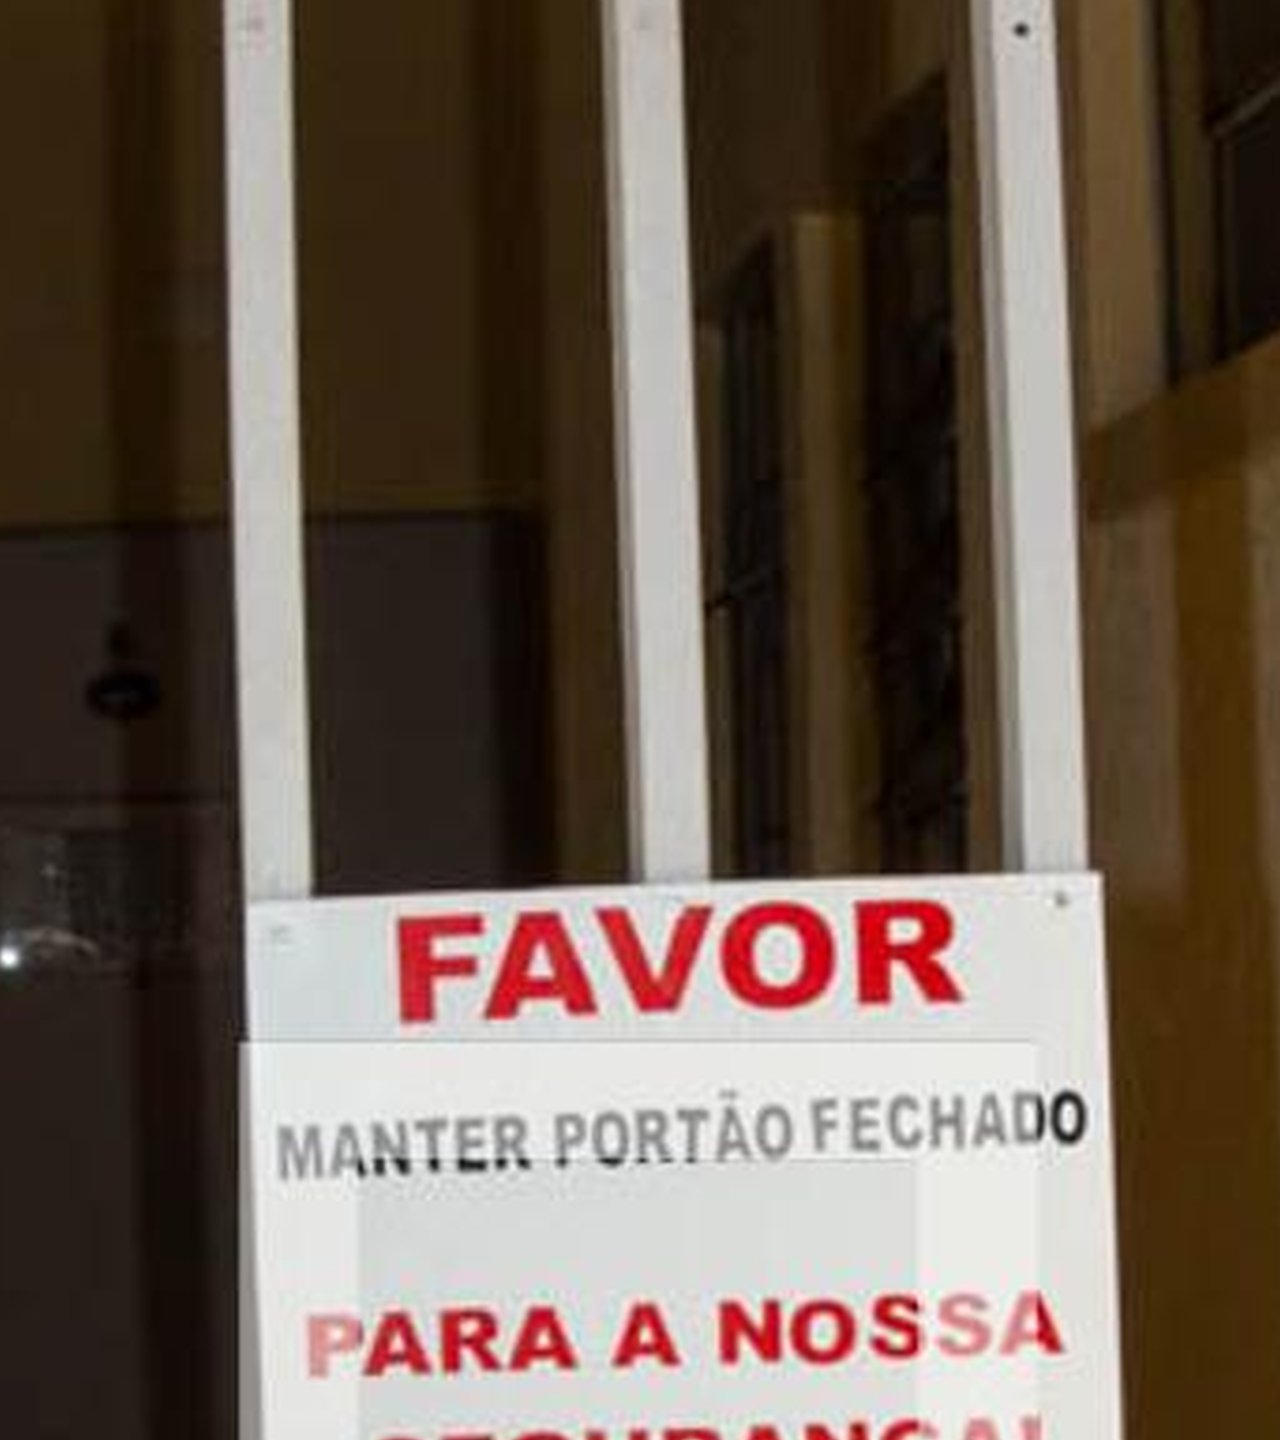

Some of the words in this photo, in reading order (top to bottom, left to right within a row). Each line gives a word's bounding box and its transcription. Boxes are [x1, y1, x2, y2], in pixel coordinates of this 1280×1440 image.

[396, 897, 964, 1027] FAVOR
[278, 1114, 533, 1182] MANTER
[552, 1089, 794, 1171] PORTÃO
[810, 1087, 1090, 1153] FECHADO
[307, 1303, 580, 1379] PARA
[611, 1299, 684, 1372] A
[713, 1288, 1066, 1370] NOSSA
